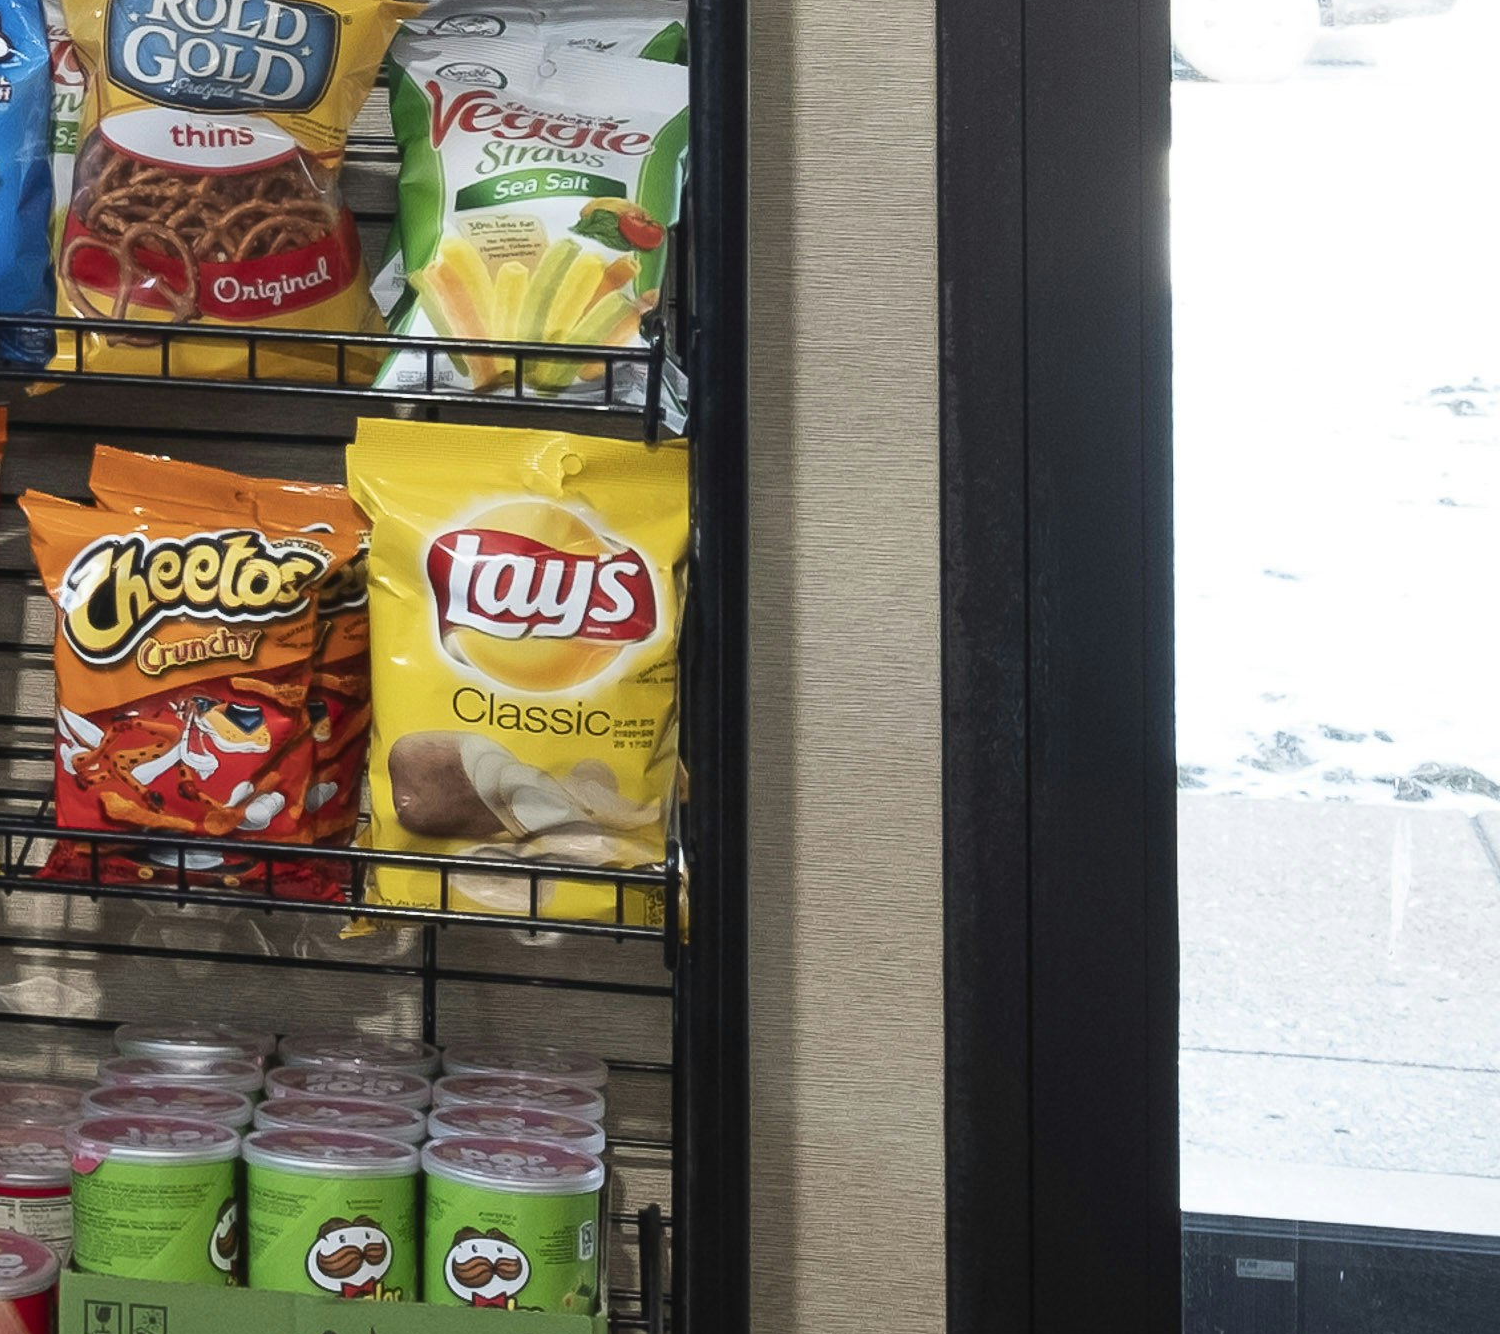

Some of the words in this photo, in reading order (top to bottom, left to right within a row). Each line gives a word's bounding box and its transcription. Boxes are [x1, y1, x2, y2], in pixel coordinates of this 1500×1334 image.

[123, 25, 305, 102] GOLD
[170, 122, 255, 148] thins
[425, 81, 656, 155] Veggie
[475, 141, 605, 175] Straws
[494, 178, 537, 199] Sea
[545, 173, 589, 192] Salt
[213, 254, 333, 305] Original
[63, 533, 331, 661] Cheetos
[445, 534, 640, 640] Lay's
[137, 627, 264, 675] Crunchy
[452, 688, 611, 737] Classic
